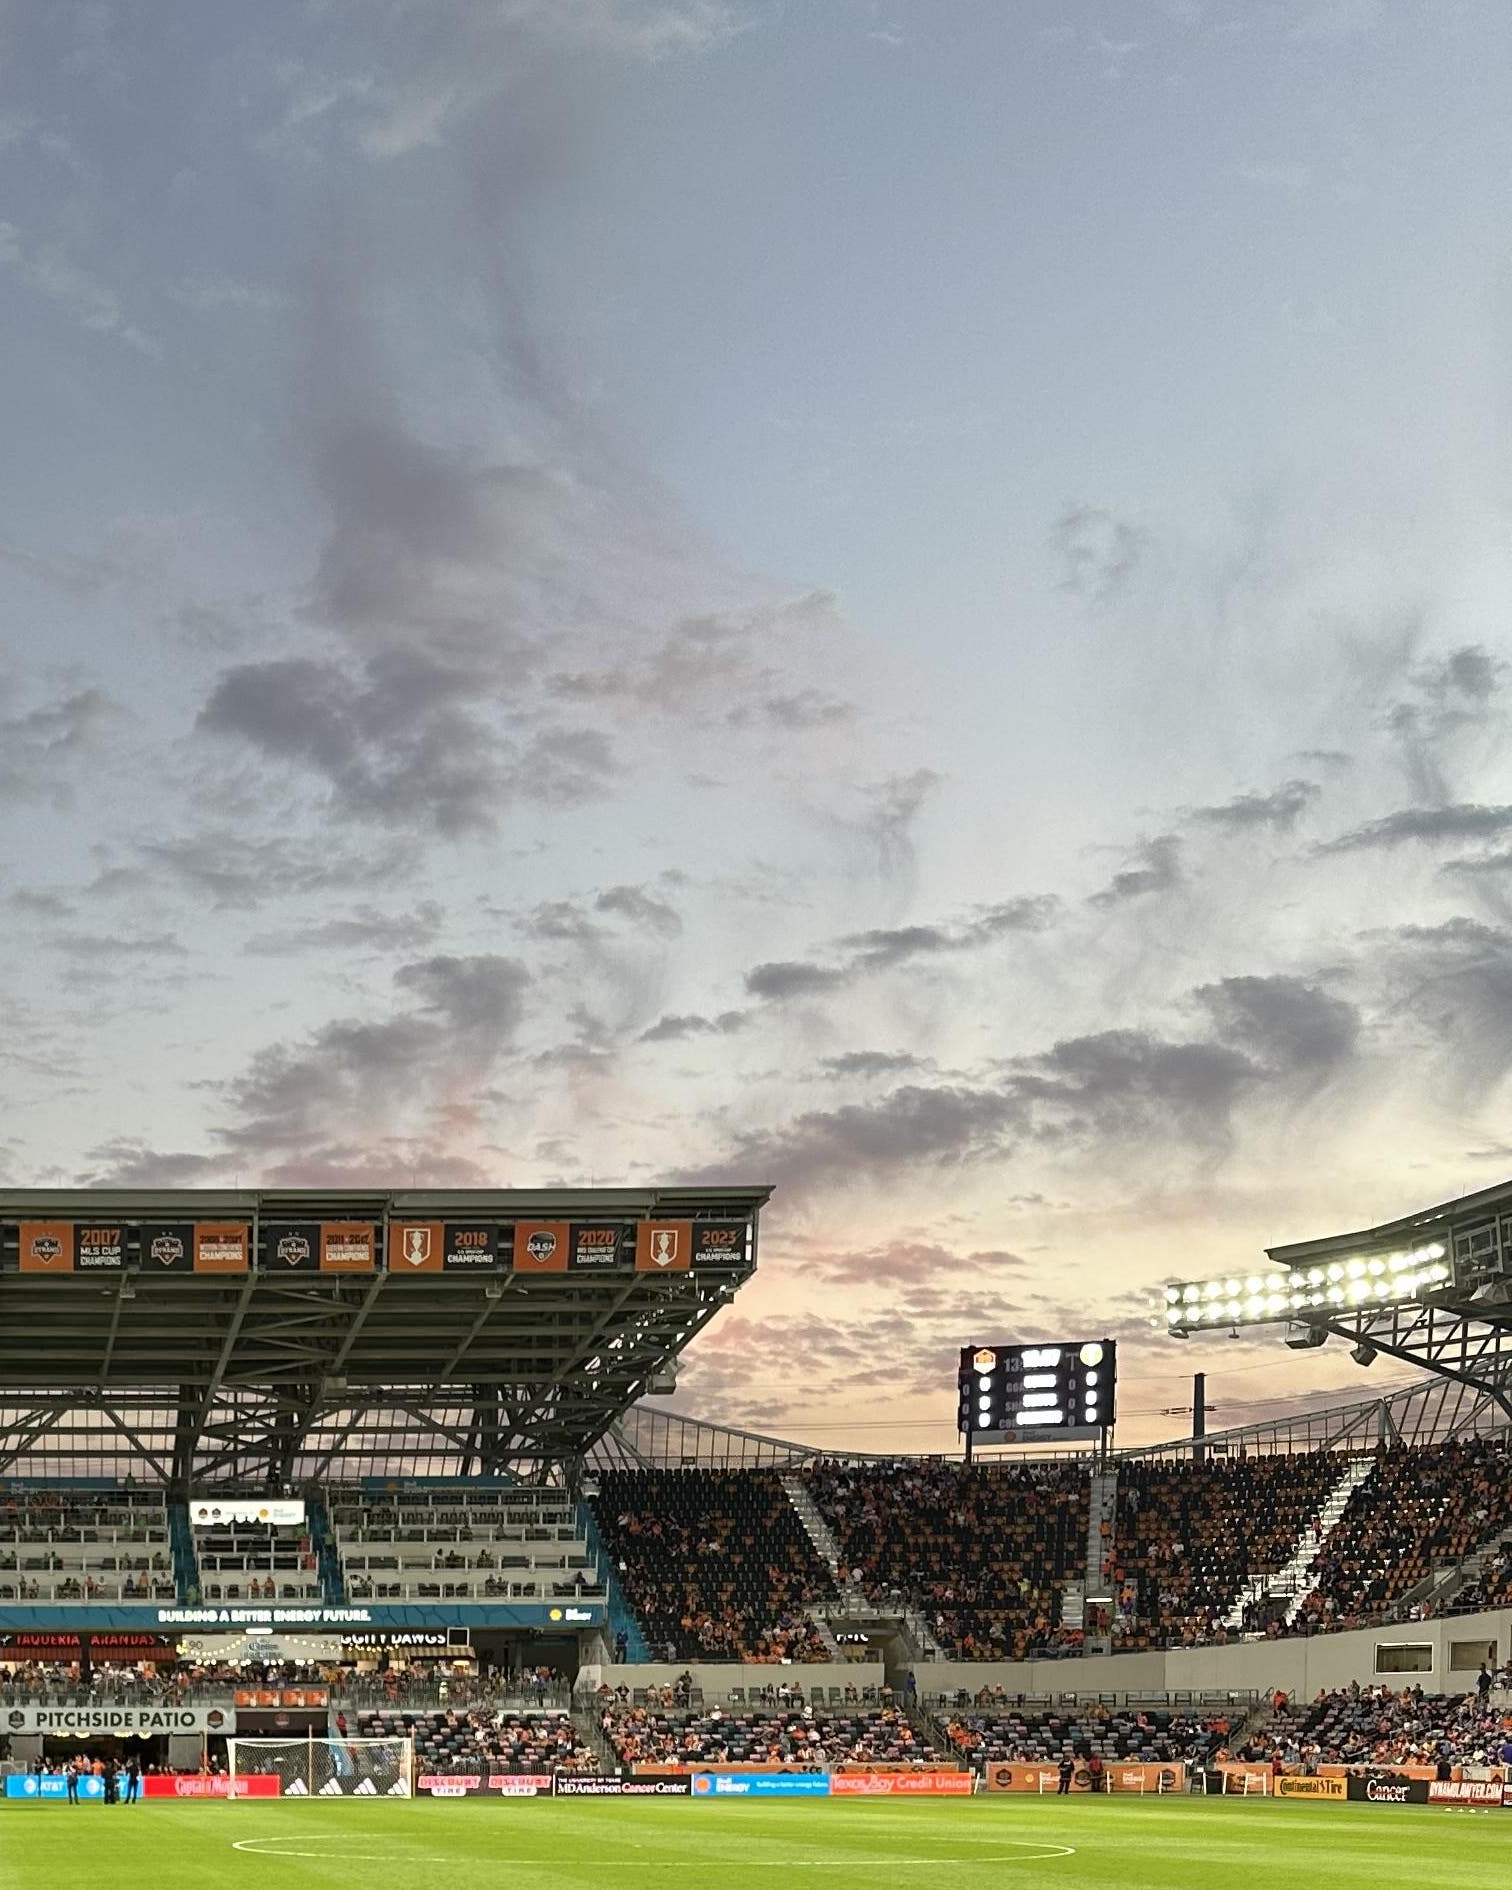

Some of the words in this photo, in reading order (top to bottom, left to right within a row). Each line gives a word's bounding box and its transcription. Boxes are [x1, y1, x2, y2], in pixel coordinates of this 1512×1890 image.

[81, 1230, 121, 1246] 2007
[454, 1232, 488, 1246] 2018
[579, 1231, 615, 1245] 2020
[80, 1247, 100, 1255] MLS
[102, 1247, 121, 1255] CUP
[199, 1251, 243, 1261] CHAMPIONS
[326, 1252, 370, 1261] CHAMPIONS
[695, 1252, 741, 1261] CHAMPIONS
[80, 1257, 121, 1266] CHAMPIONS
[447, 1254, 493, 1263] CHAMPIONS
[158, 1609, 219, 1622] BUILDING
[219, 1609, 230, 1622] A
[231, 1609, 272, 1622] BETTER
[274, 1609, 322, 1622] ENERGY
[323, 1609, 372, 1622] FUTURE.
[16, 1635, 80, 1645] TAQUERIA
[91, 1635, 156, 1645] ARANDAS
[37, 1712, 134, 1727] PITCHSIDE
[139, 1712, 196, 1727] PATIO
[40, 1781, 65, 1792] AT&T
[211, 1776, 249, 1794] Moran
[897, 1775, 933, 1789] Credit
[935, 1775, 971, 1789] Union
[1280, 1778, 1319, 1794] Continental
[1326, 1778, 1343, 1794] Tire
[622, 1783, 656, 1793] Cancer
[656, 1783, 687, 1793] Center
